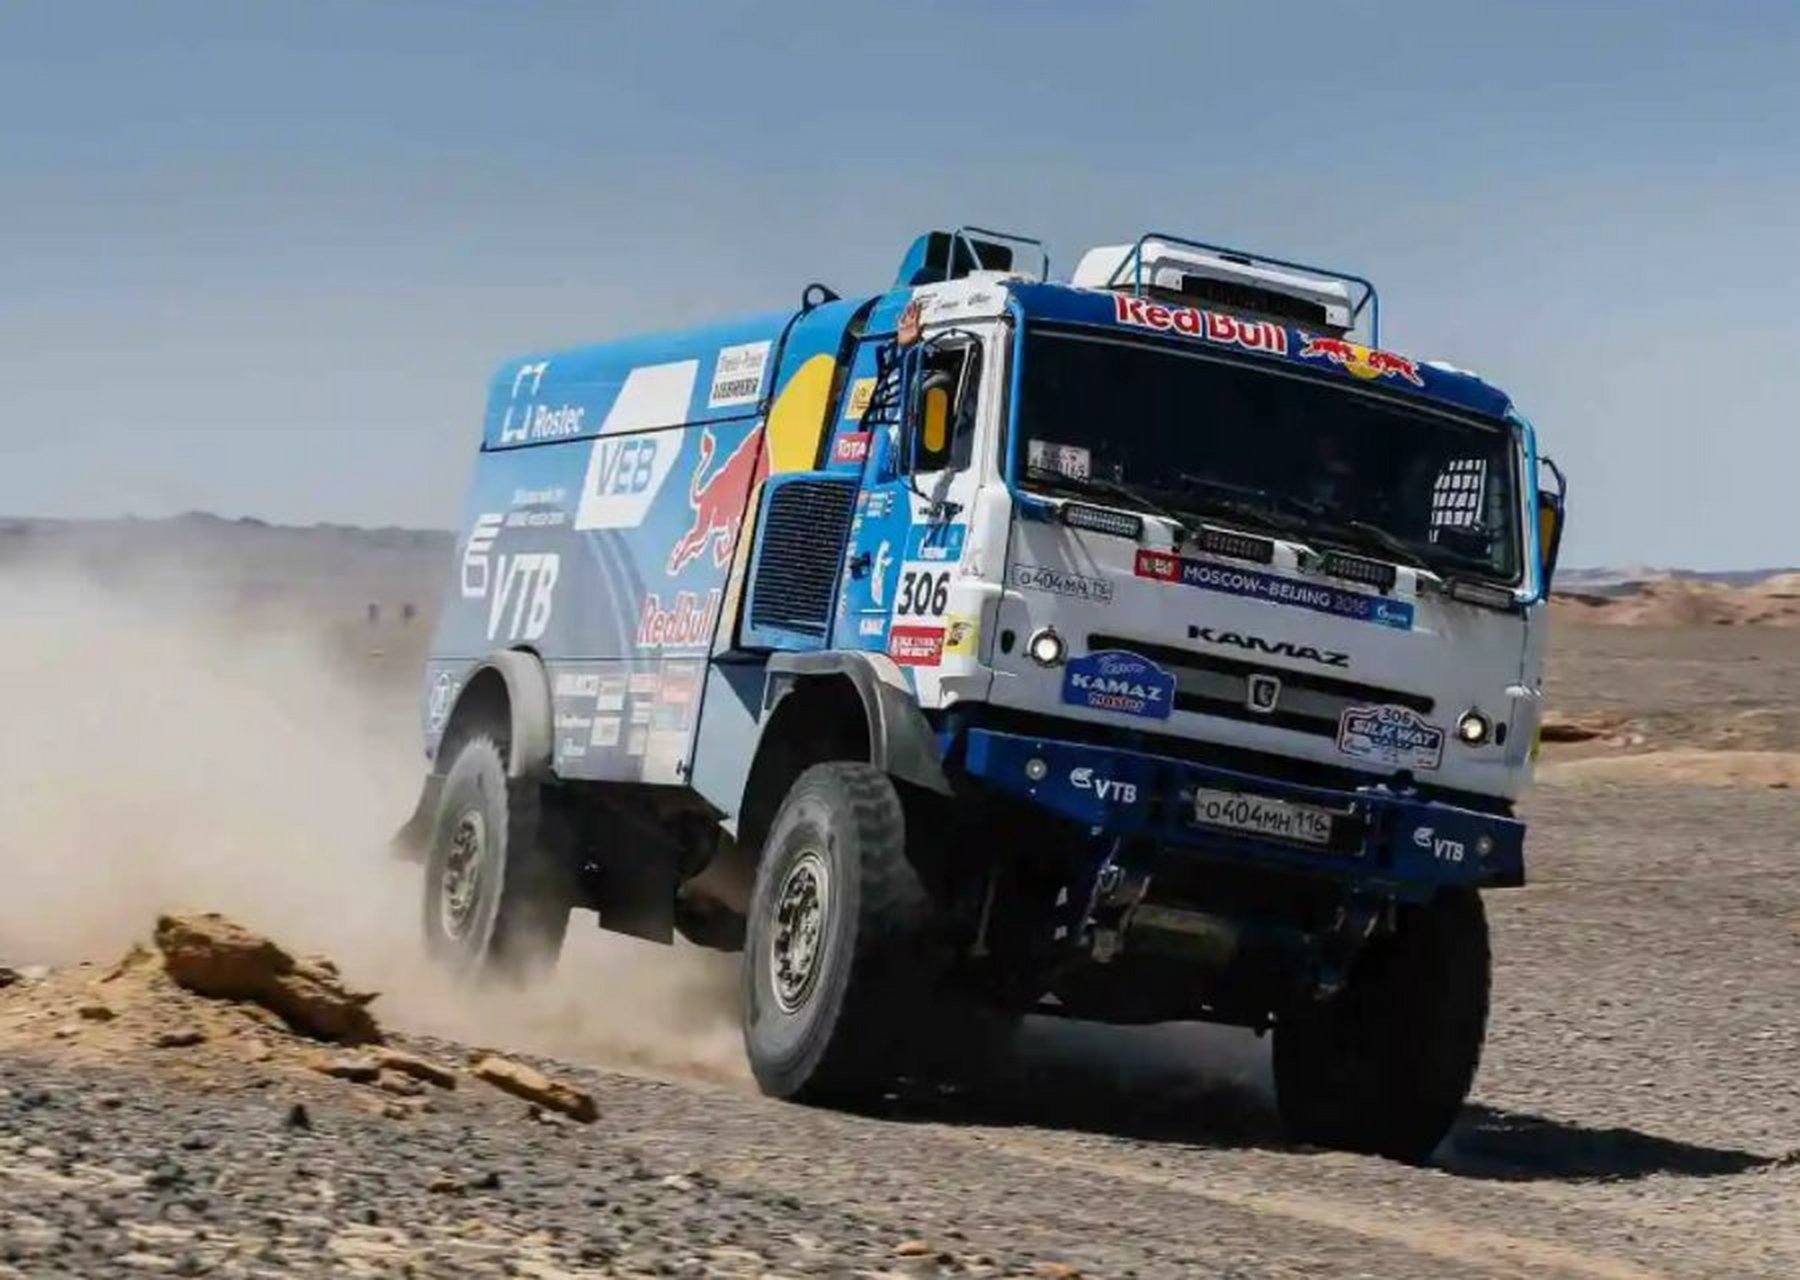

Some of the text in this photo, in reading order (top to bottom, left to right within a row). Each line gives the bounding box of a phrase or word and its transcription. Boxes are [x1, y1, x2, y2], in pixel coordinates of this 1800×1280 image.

[1114, 294, 1287, 356] Red Bull
[533, 405, 585, 437] Rostec
[596, 440, 657, 497] VEB
[487, 553, 560, 641] VTB
[898, 572, 950, 616] 306
[1187, 624, 1350, 668] KAMAZ
[1071, 673, 1163, 701] KAMAZ
[1381, 707, 1412, 725] 306
[1094, 780, 1137, 804] VTB
[1433, 837, 1465, 861] VTB
